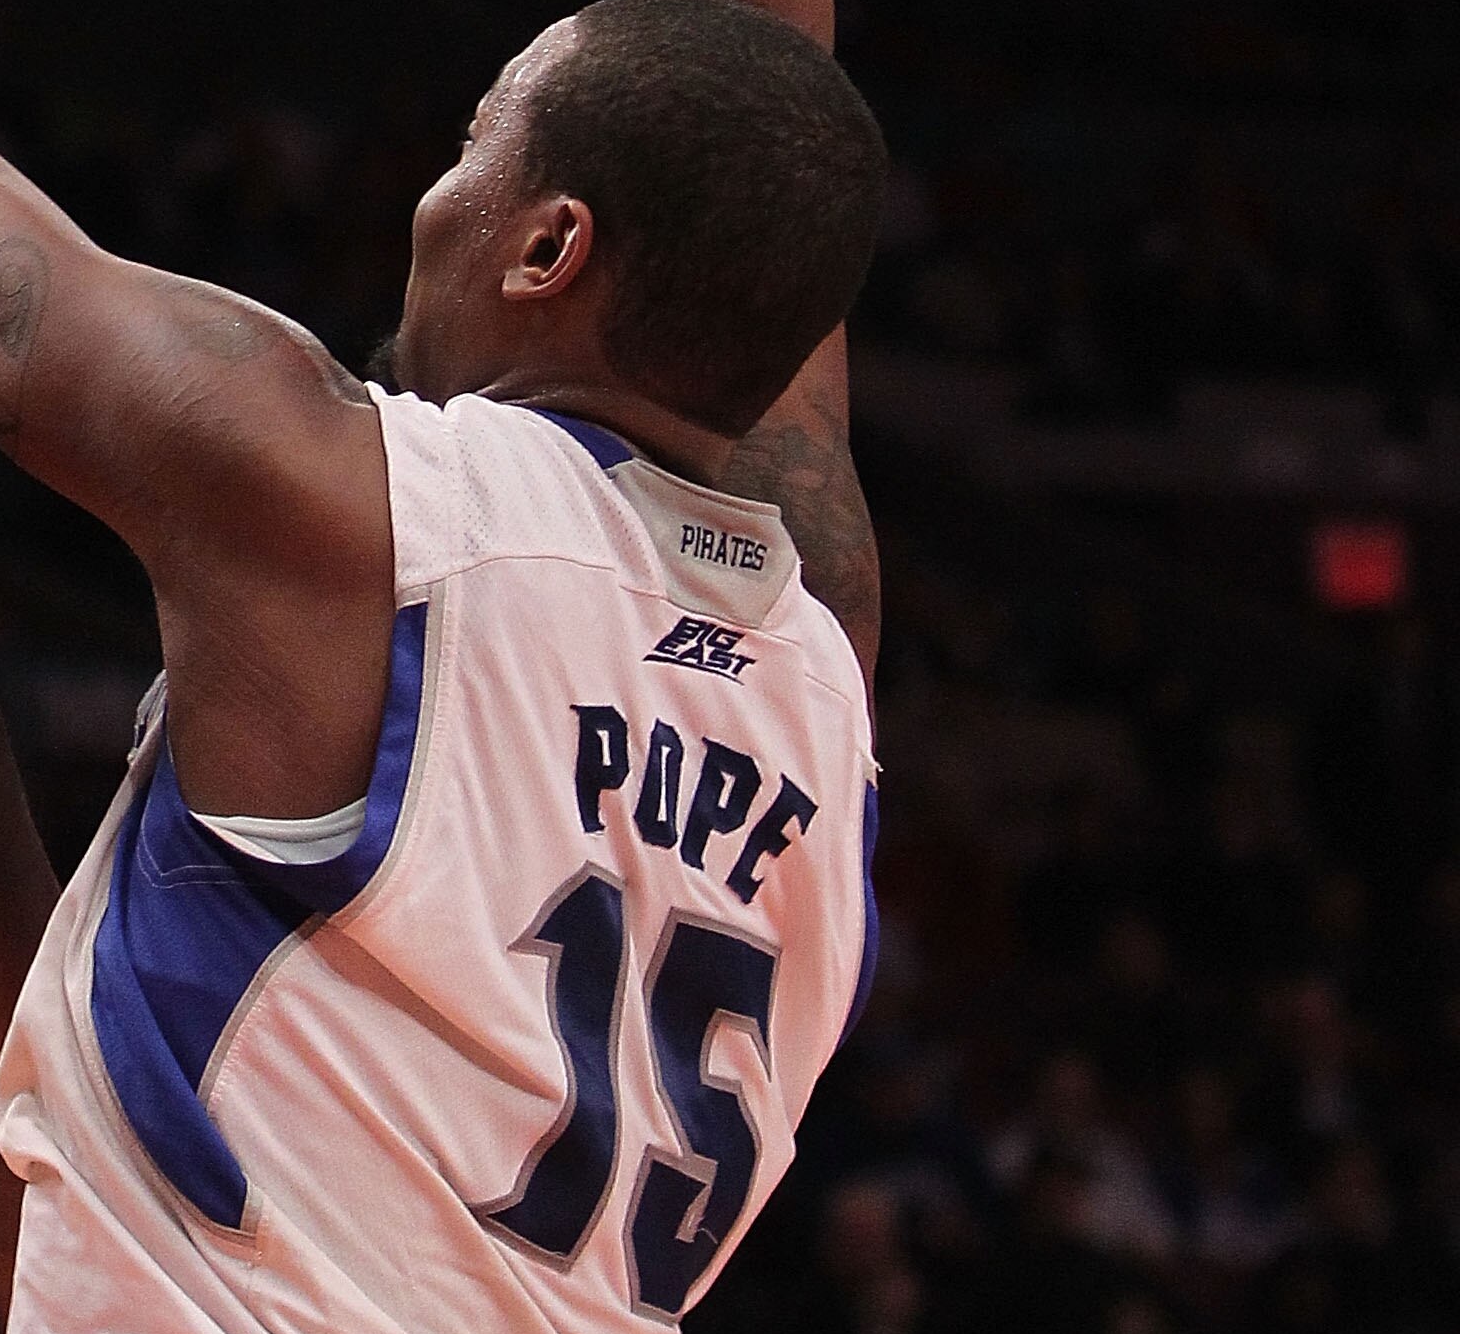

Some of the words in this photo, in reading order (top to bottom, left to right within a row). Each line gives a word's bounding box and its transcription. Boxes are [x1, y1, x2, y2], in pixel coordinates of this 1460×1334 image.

[680, 524, 767, 571] PIRATES
[653, 633, 758, 675] EAST
[666, 616, 746, 651] BIG
[570, 705, 819, 905] POPE
[470, 860, 783, 1327] 15
